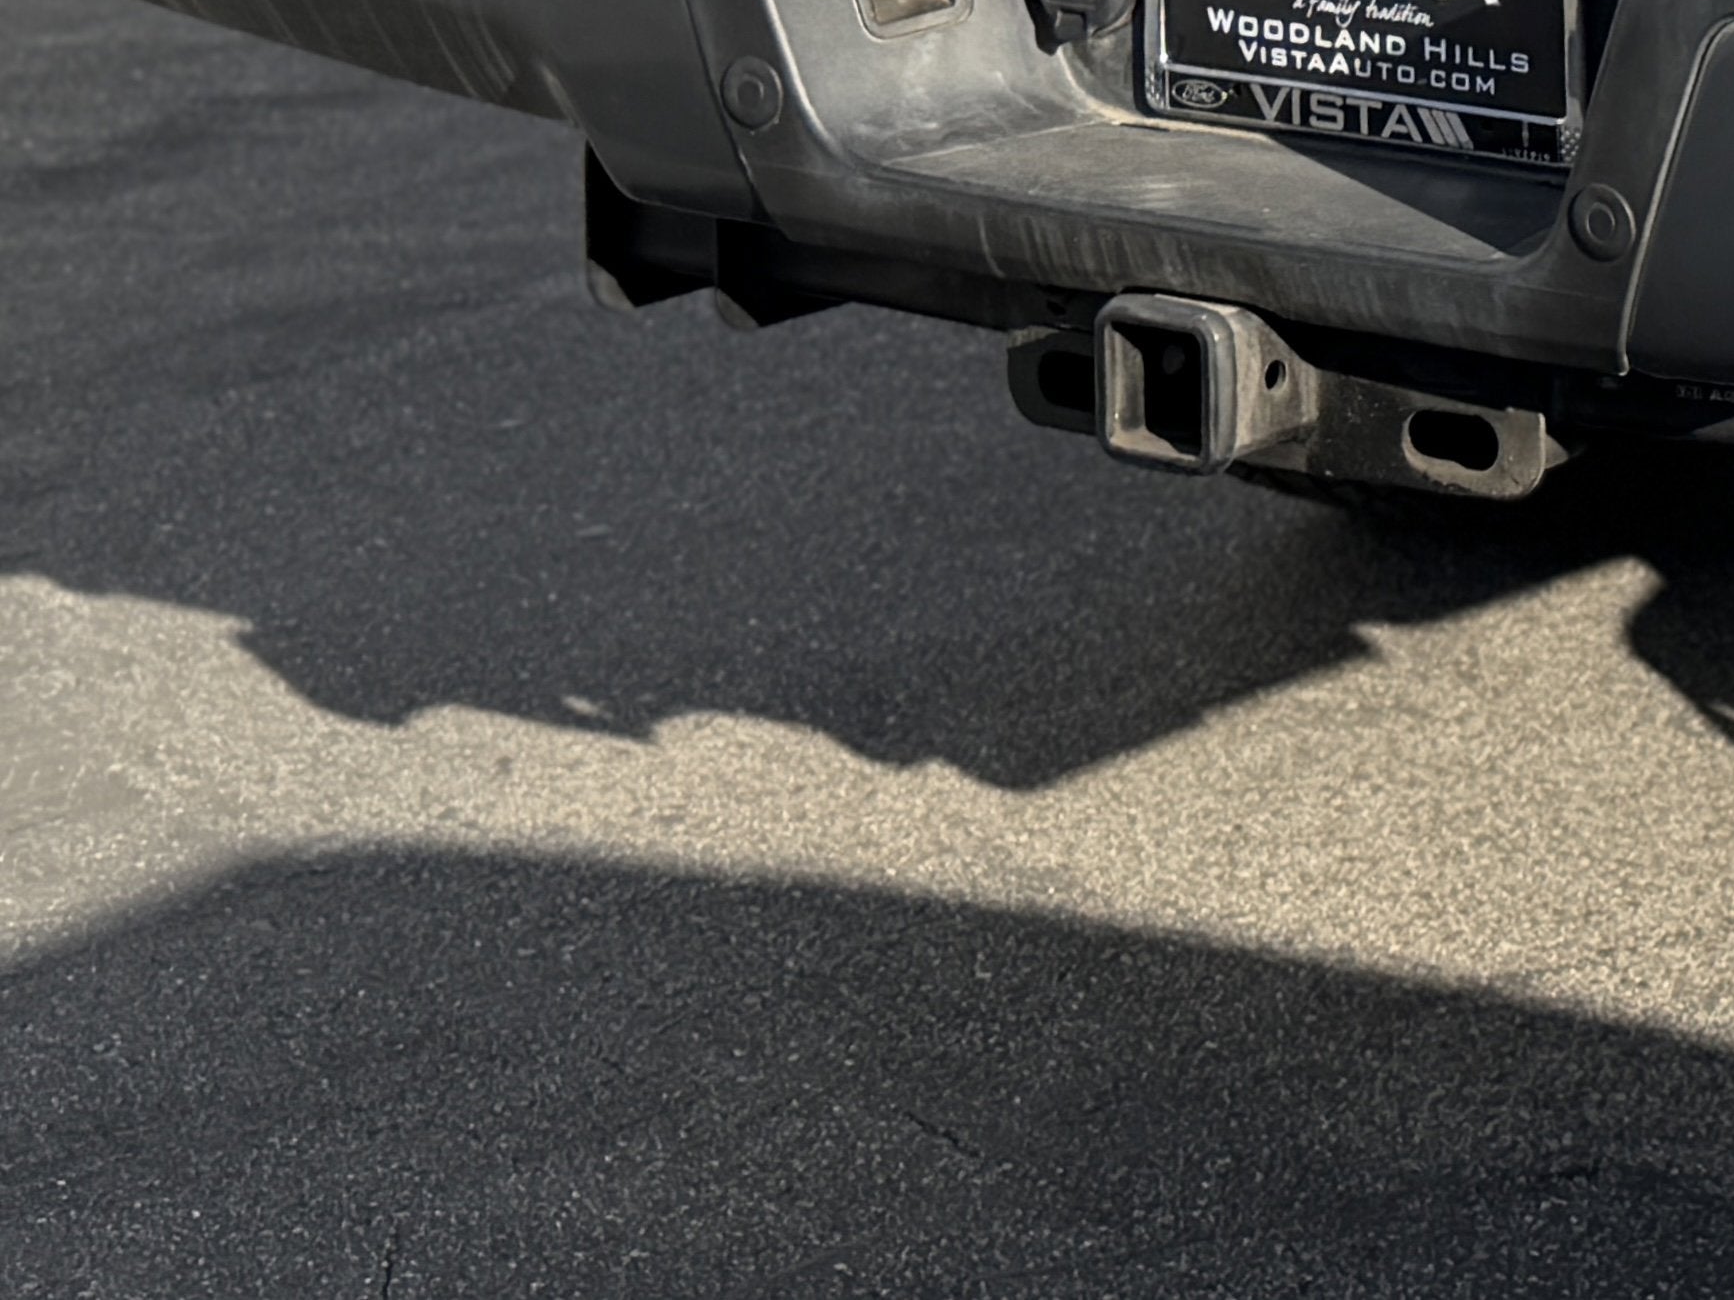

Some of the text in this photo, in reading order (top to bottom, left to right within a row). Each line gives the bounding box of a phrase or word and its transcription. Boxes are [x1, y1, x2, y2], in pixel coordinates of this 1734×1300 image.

[1207, 6, 1530, 73] WOODLAND HILLS
[1250, 82, 1424, 143] VISTA
